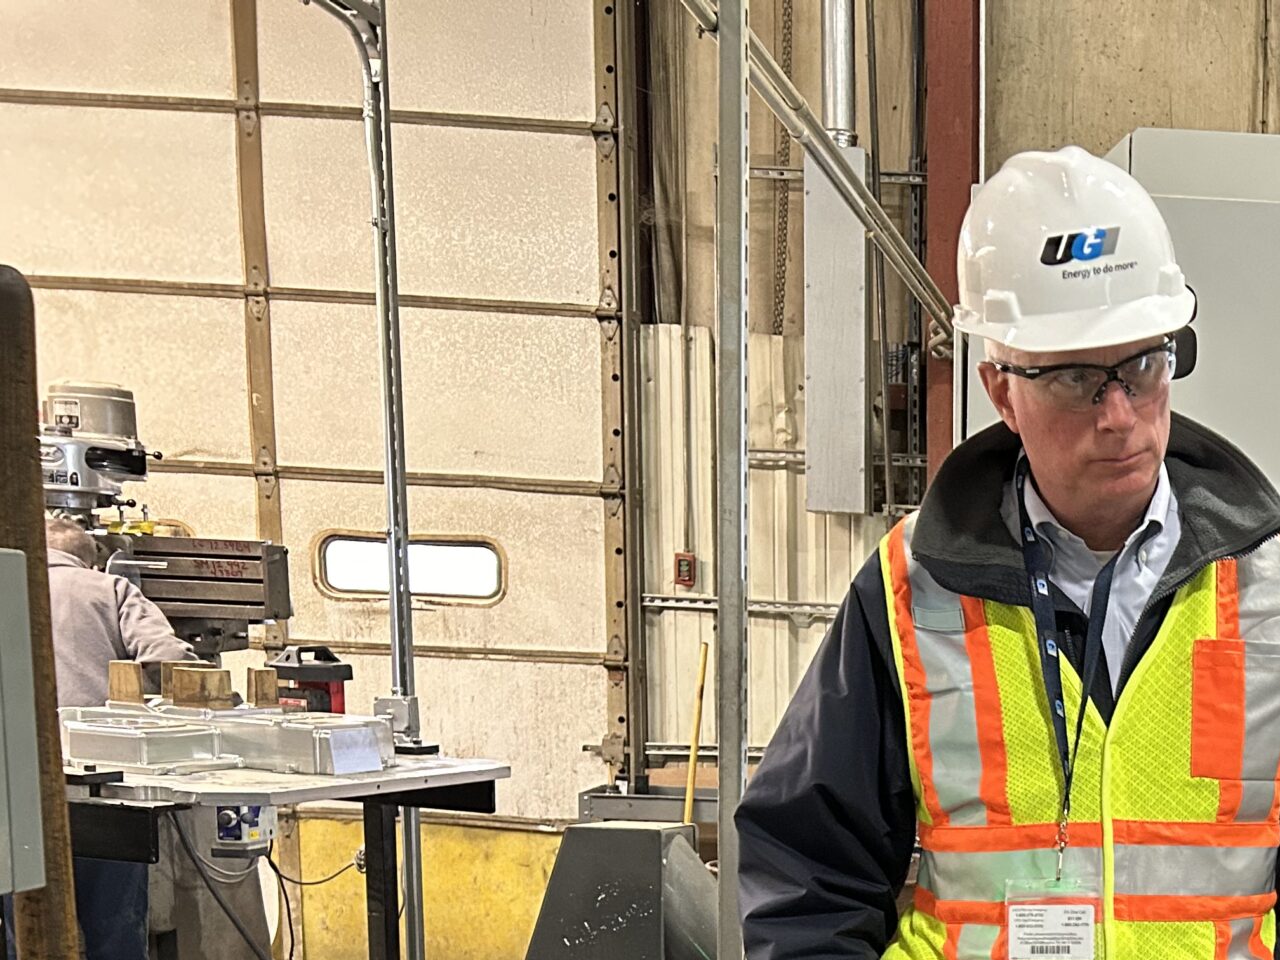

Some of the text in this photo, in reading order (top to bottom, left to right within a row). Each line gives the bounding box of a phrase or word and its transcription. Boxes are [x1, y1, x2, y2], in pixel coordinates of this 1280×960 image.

[1040, 226, 1121, 266] UGI
[1062, 269, 1091, 280] Energy
[1093, 266, 1102, 275] to
[1102, 263, 1113, 274] do
